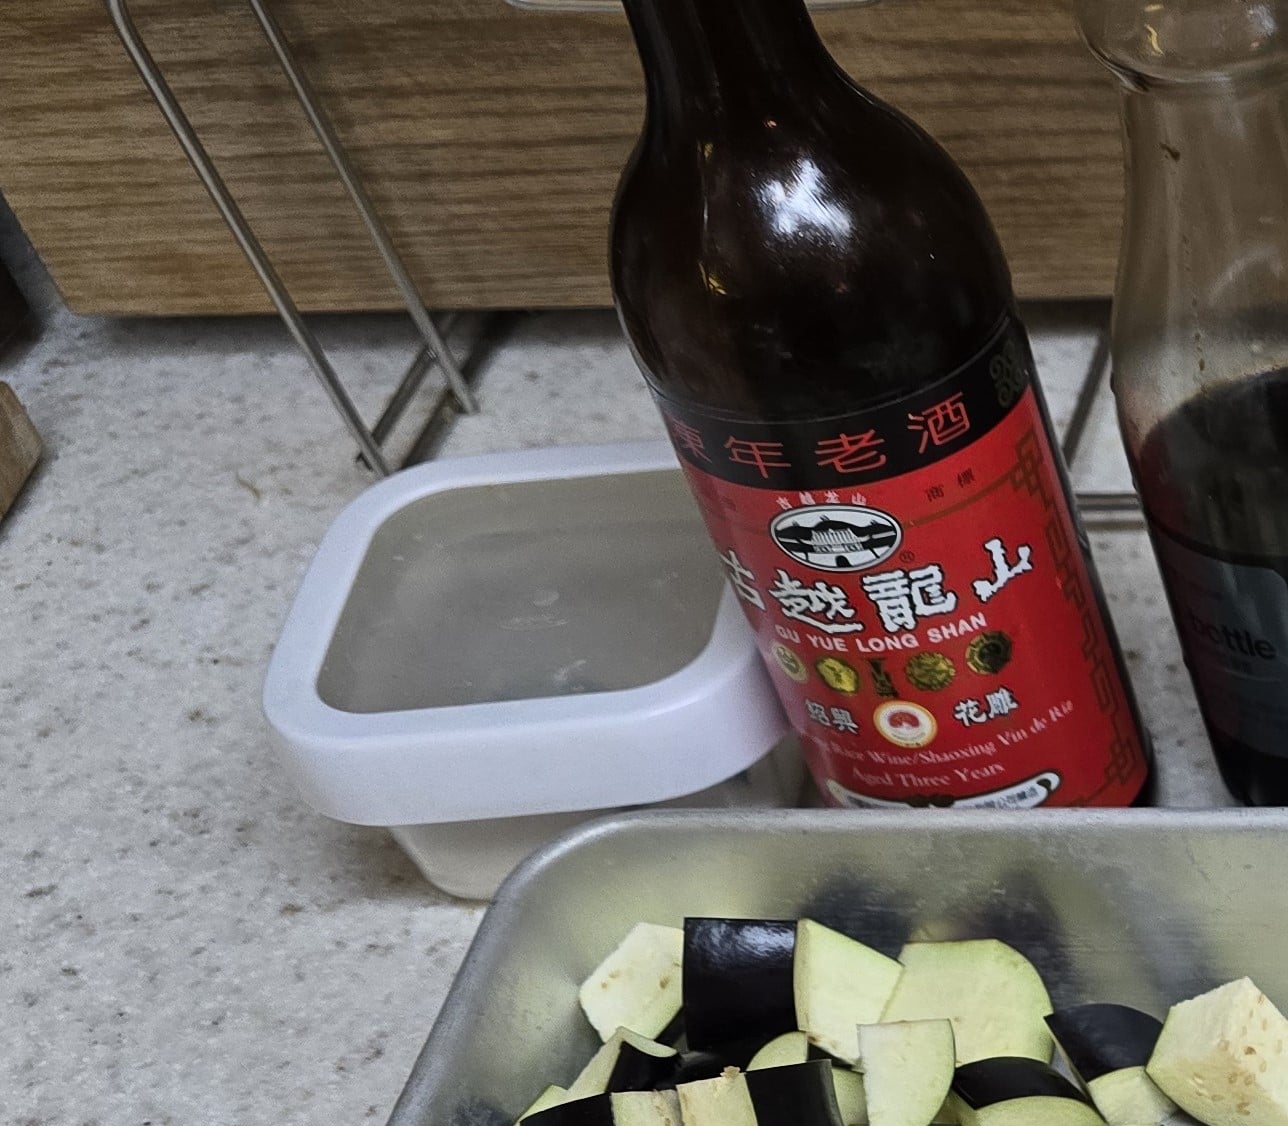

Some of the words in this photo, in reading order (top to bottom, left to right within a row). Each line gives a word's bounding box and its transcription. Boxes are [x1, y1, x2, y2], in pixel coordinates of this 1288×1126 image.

[774, 623, 800, 645] GU
[807, 633, 849, 653] YUE
[855, 633, 920, 654] LONG
[927, 612, 988, 644] SHAN
[953, 686, 1019, 728] 花雕
[896, 772, 951, 789] Three
[953, 762, 1006, 784] Years
